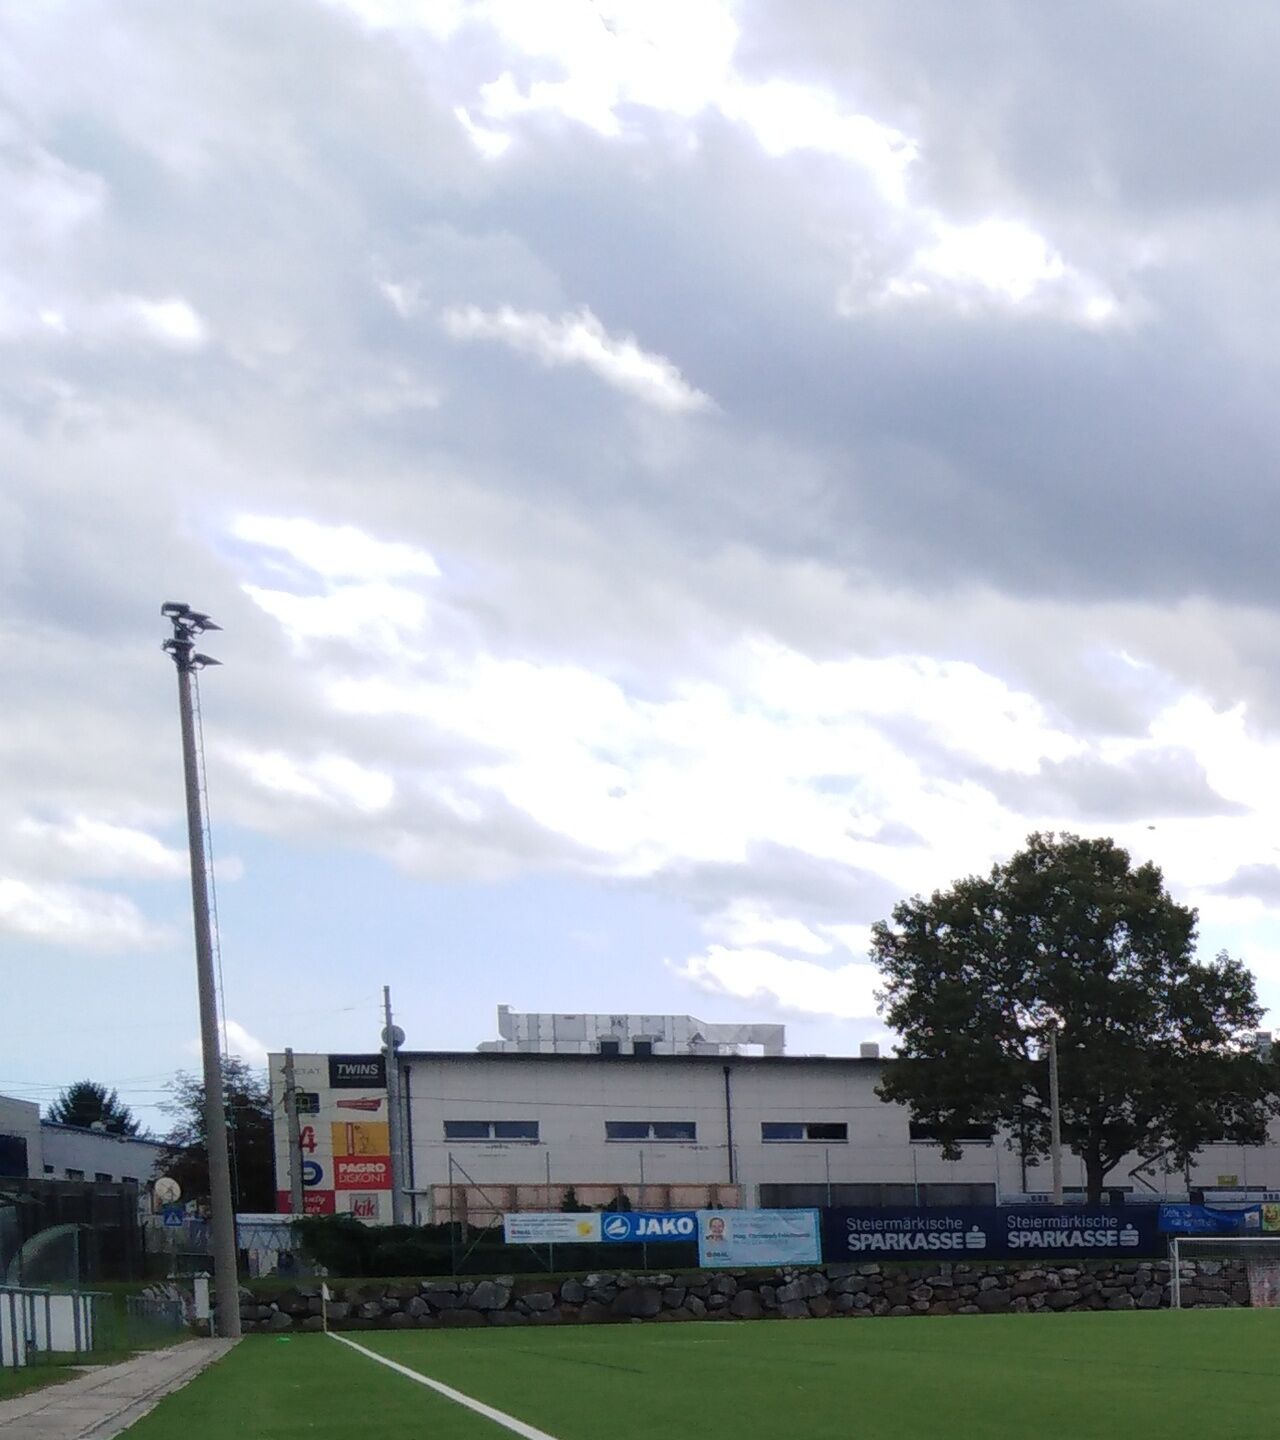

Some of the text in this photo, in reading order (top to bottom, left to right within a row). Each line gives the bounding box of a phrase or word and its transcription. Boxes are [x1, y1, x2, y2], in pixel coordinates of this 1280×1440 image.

[337, 1064, 379, 1076] TWINS
[338, 1163, 386, 1174] PAGRO
[338, 1174, 386, 1183] DISKONT
[353, 1198, 376, 1217] kik
[636, 1216, 694, 1236] JAKO
[846, 1217, 963, 1231] Steiermärkische
[1007, 1215, 1118, 1228] Steiermärkische
[848, 1232, 964, 1251] SPARKASSE
[1007, 1230, 1118, 1248] SPARKASSE
